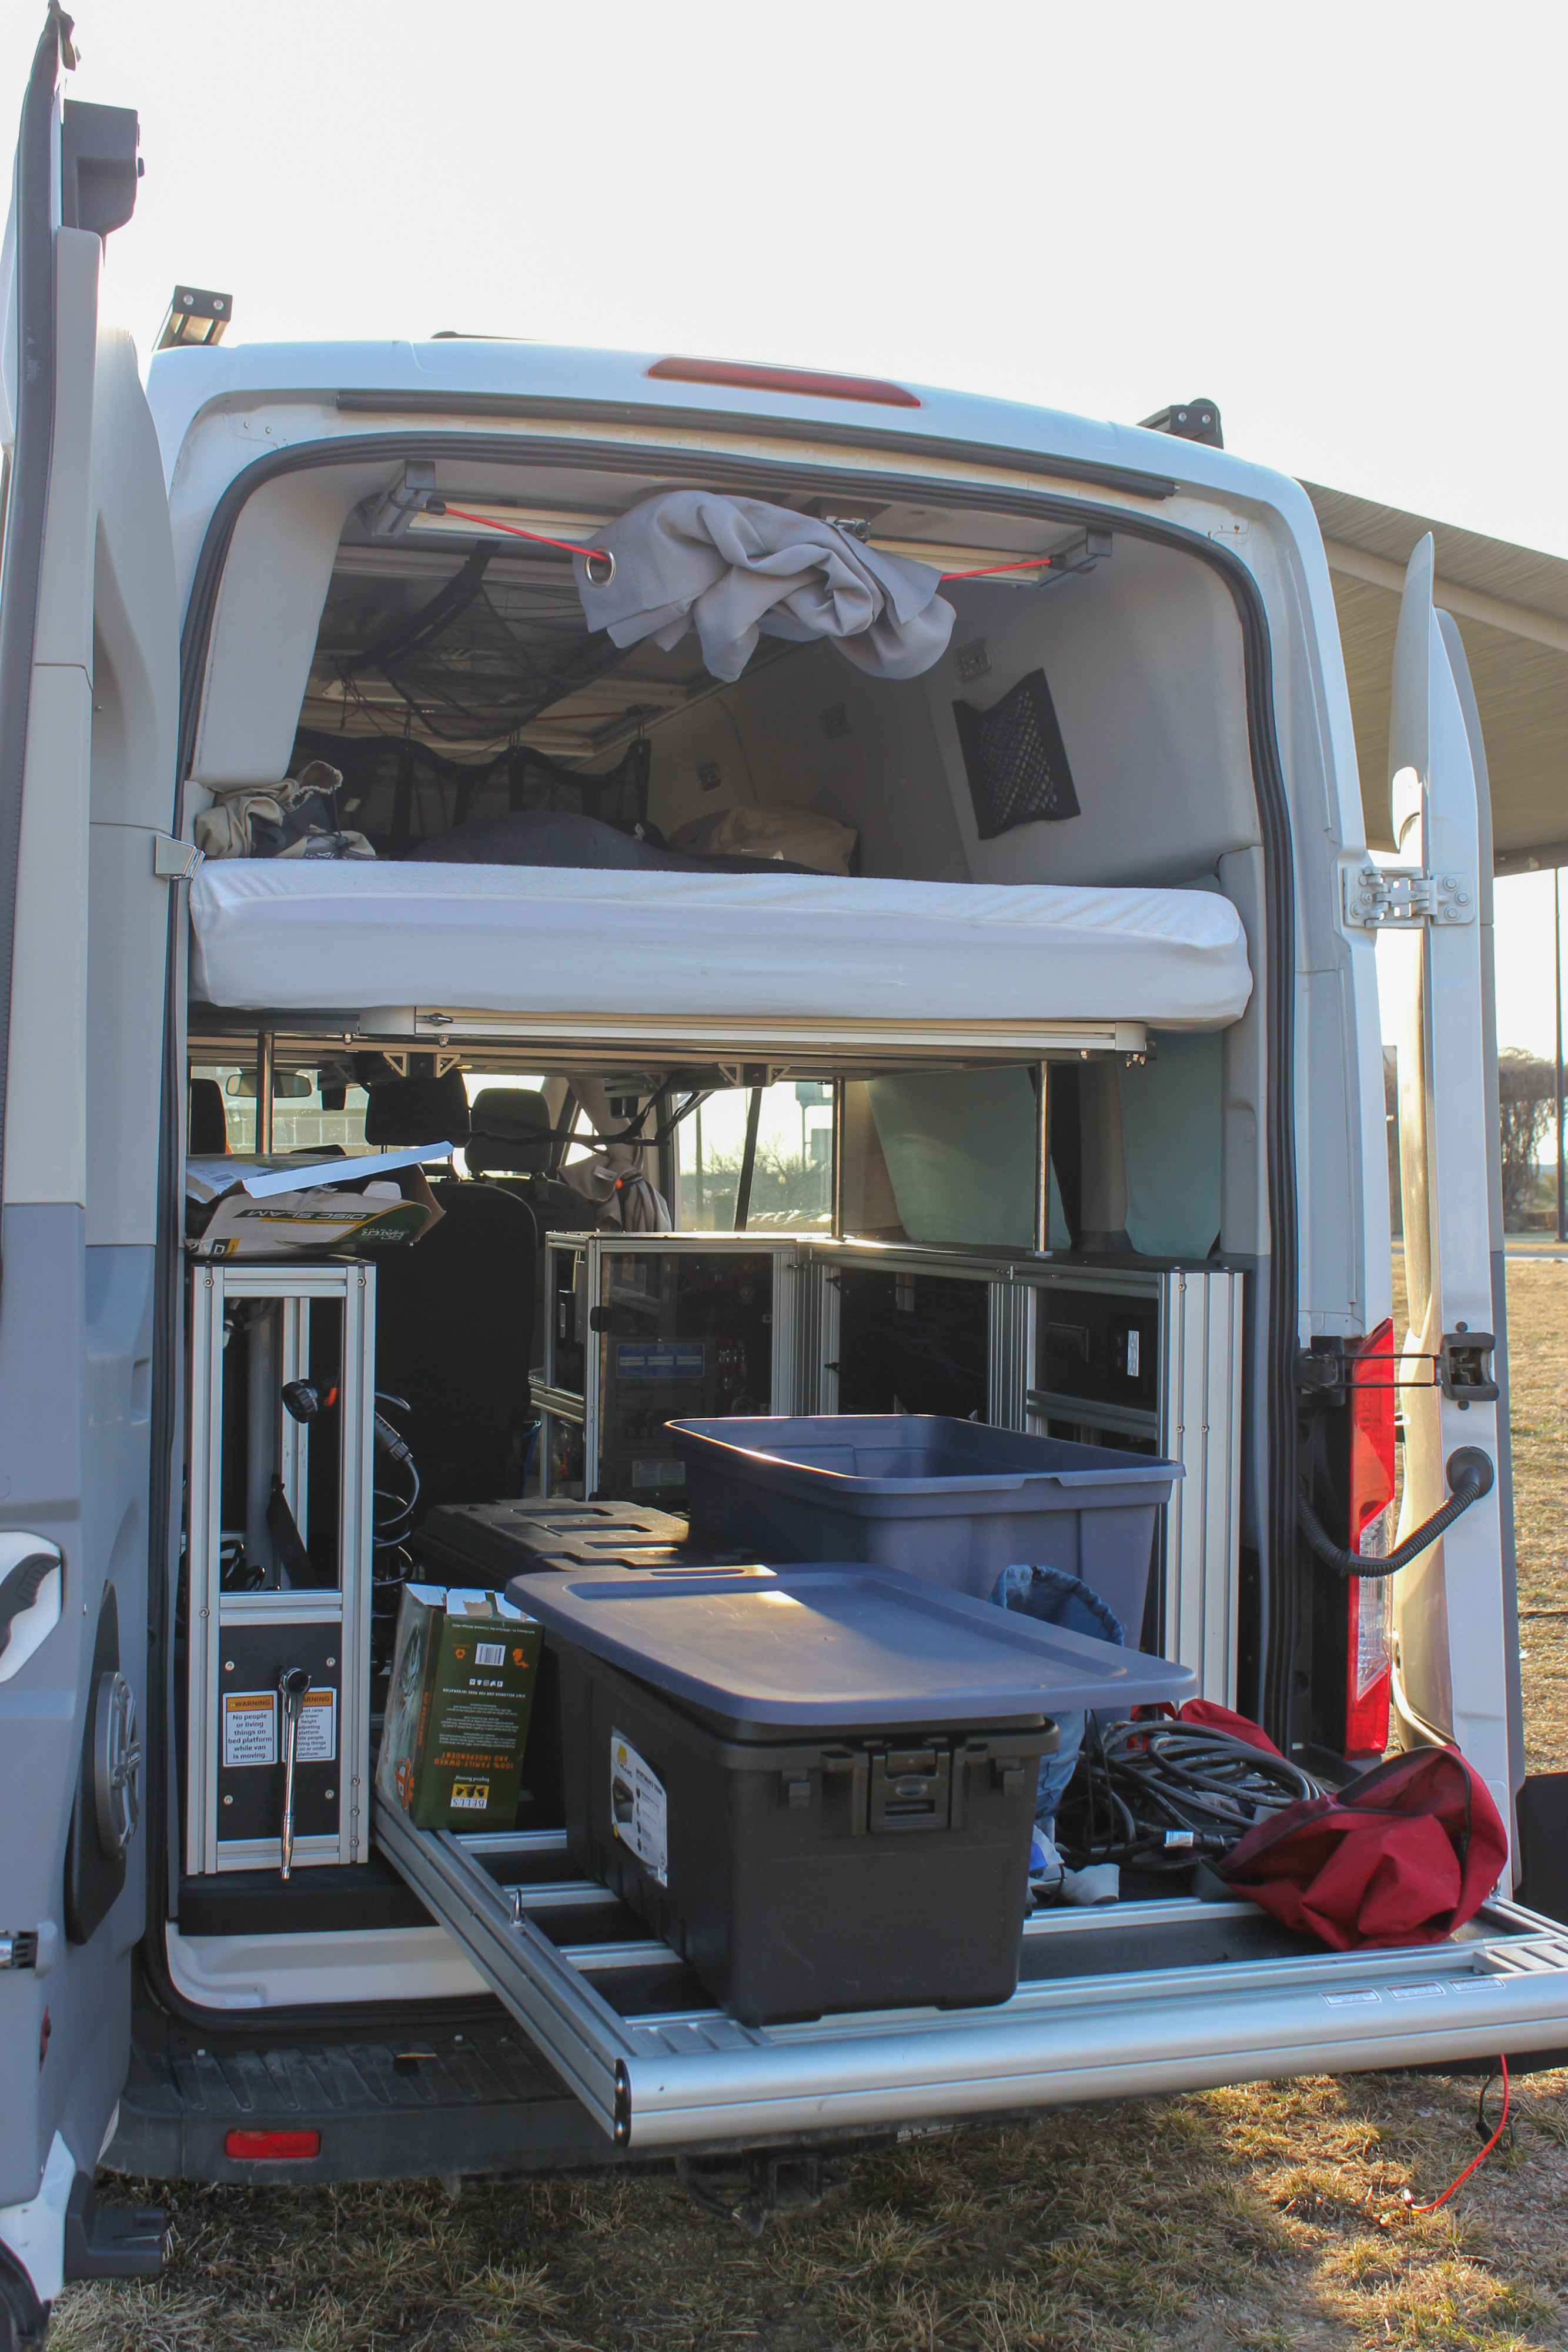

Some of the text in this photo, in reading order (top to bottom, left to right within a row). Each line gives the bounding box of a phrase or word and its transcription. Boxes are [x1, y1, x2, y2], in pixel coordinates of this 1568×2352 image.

[242, 1736, 272, 1745] platform
[442, 1752, 491, 1761] INDEPENDENT
[434, 1758, 490, 1769] FAMILY-OWNED
[453, 1798, 484, 1808] BELL'S
